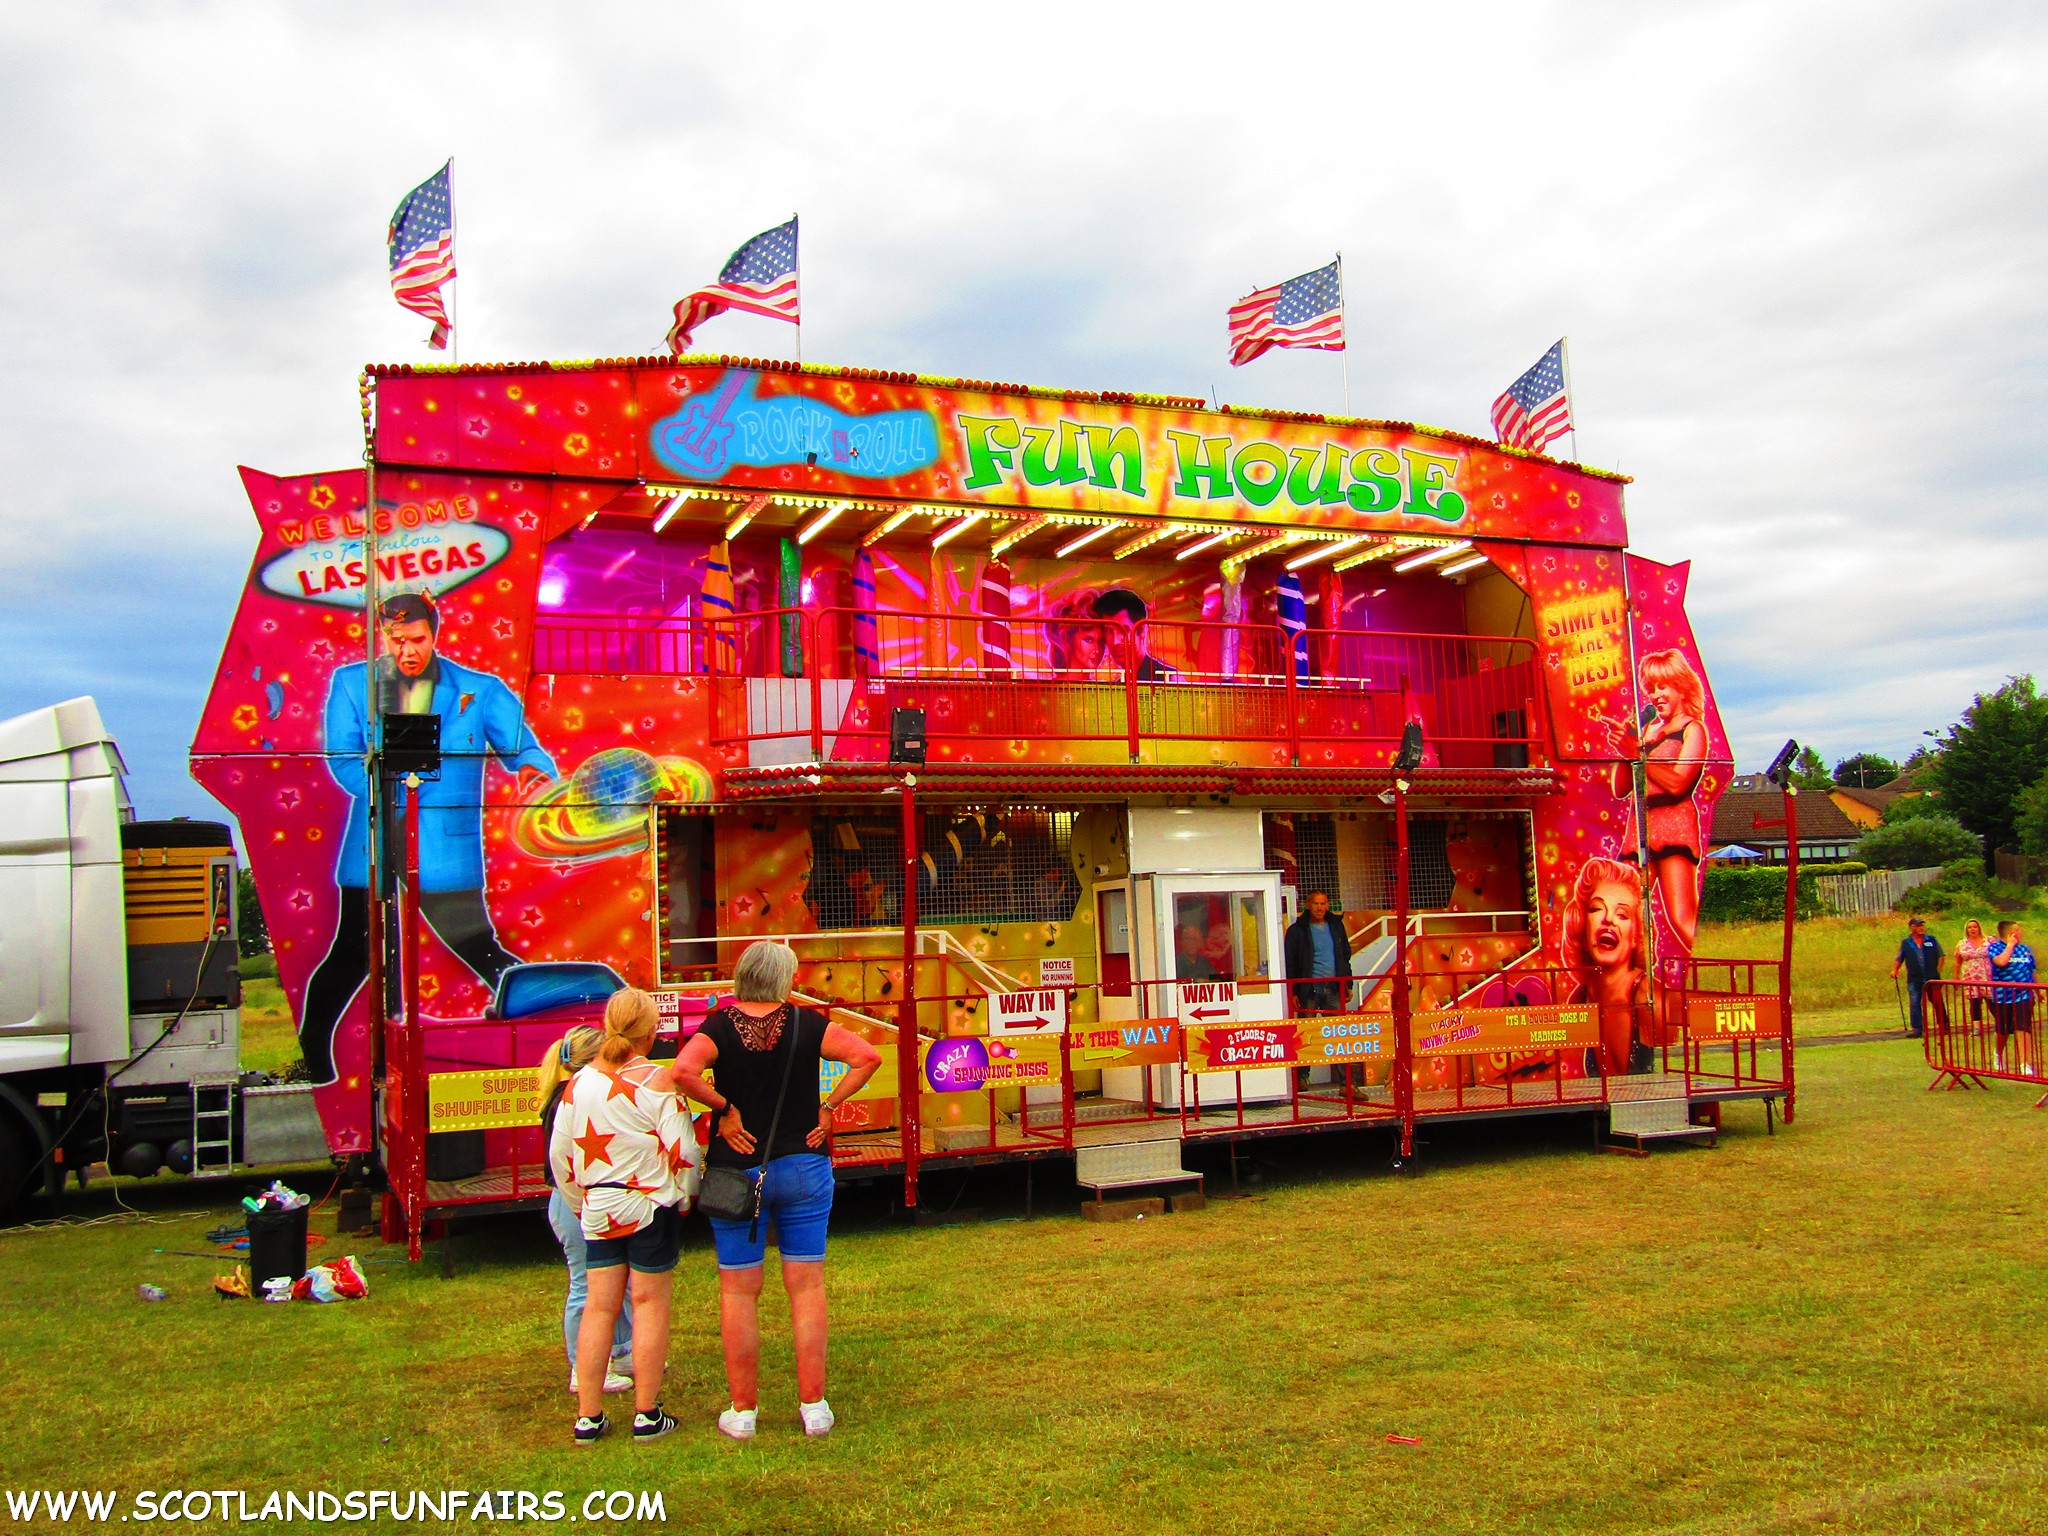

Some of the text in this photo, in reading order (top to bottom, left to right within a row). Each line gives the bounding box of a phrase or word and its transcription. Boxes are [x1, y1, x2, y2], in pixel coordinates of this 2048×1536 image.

[737, 406, 926, 472] ROCK N ROLL
[957, 414, 1465, 522] FUN HOUSE
[281, 497, 473, 543] WELCOME
[310, 550, 334, 561] TO
[298, 542, 486, 596] LAS VEGAS
[356, 579, 444, 601] NVADA
[1544, 593, 1620, 638] SIMPLY
[1577, 634, 1604, 654] THE
[1570, 651, 1620, 688] BEST
[1042, 961, 1072, 970] NOTICE
[1042, 973, 1074, 982] NO RUNNING
[999, 992, 1056, 1015] WAY IN
[1182, 983, 1234, 1004] WAY IN
[1430, 1014, 1464, 1032] WACKY
[1505, 1011, 1589, 1027] ITS A DOUBLE DOSE OF
[1715, 1010, 1756, 1033] FUN
[1088, 1030, 1119, 1048] THIS
[1121, 1025, 1172, 1046] WAY
[1227, 1029, 1278, 1045] 2 FLOORS OF
[1321, 1022, 1381, 1038] GIGGLES
[1419, 1024, 1482, 1051] MOVING FLOORS
[1530, 1030, 1567, 1042] MADNESS
[1220, 1044, 1285, 1063] CRAZY FUN
[1323, 1040, 1380, 1056] GALORE
[933, 1044, 971, 1081] CRAZY
[953, 1061, 1048, 1083] SPINNING DISCS
[483, 1077, 541, 1095] SUPER
[433, 1097, 542, 1118] SHUFFLE BO
